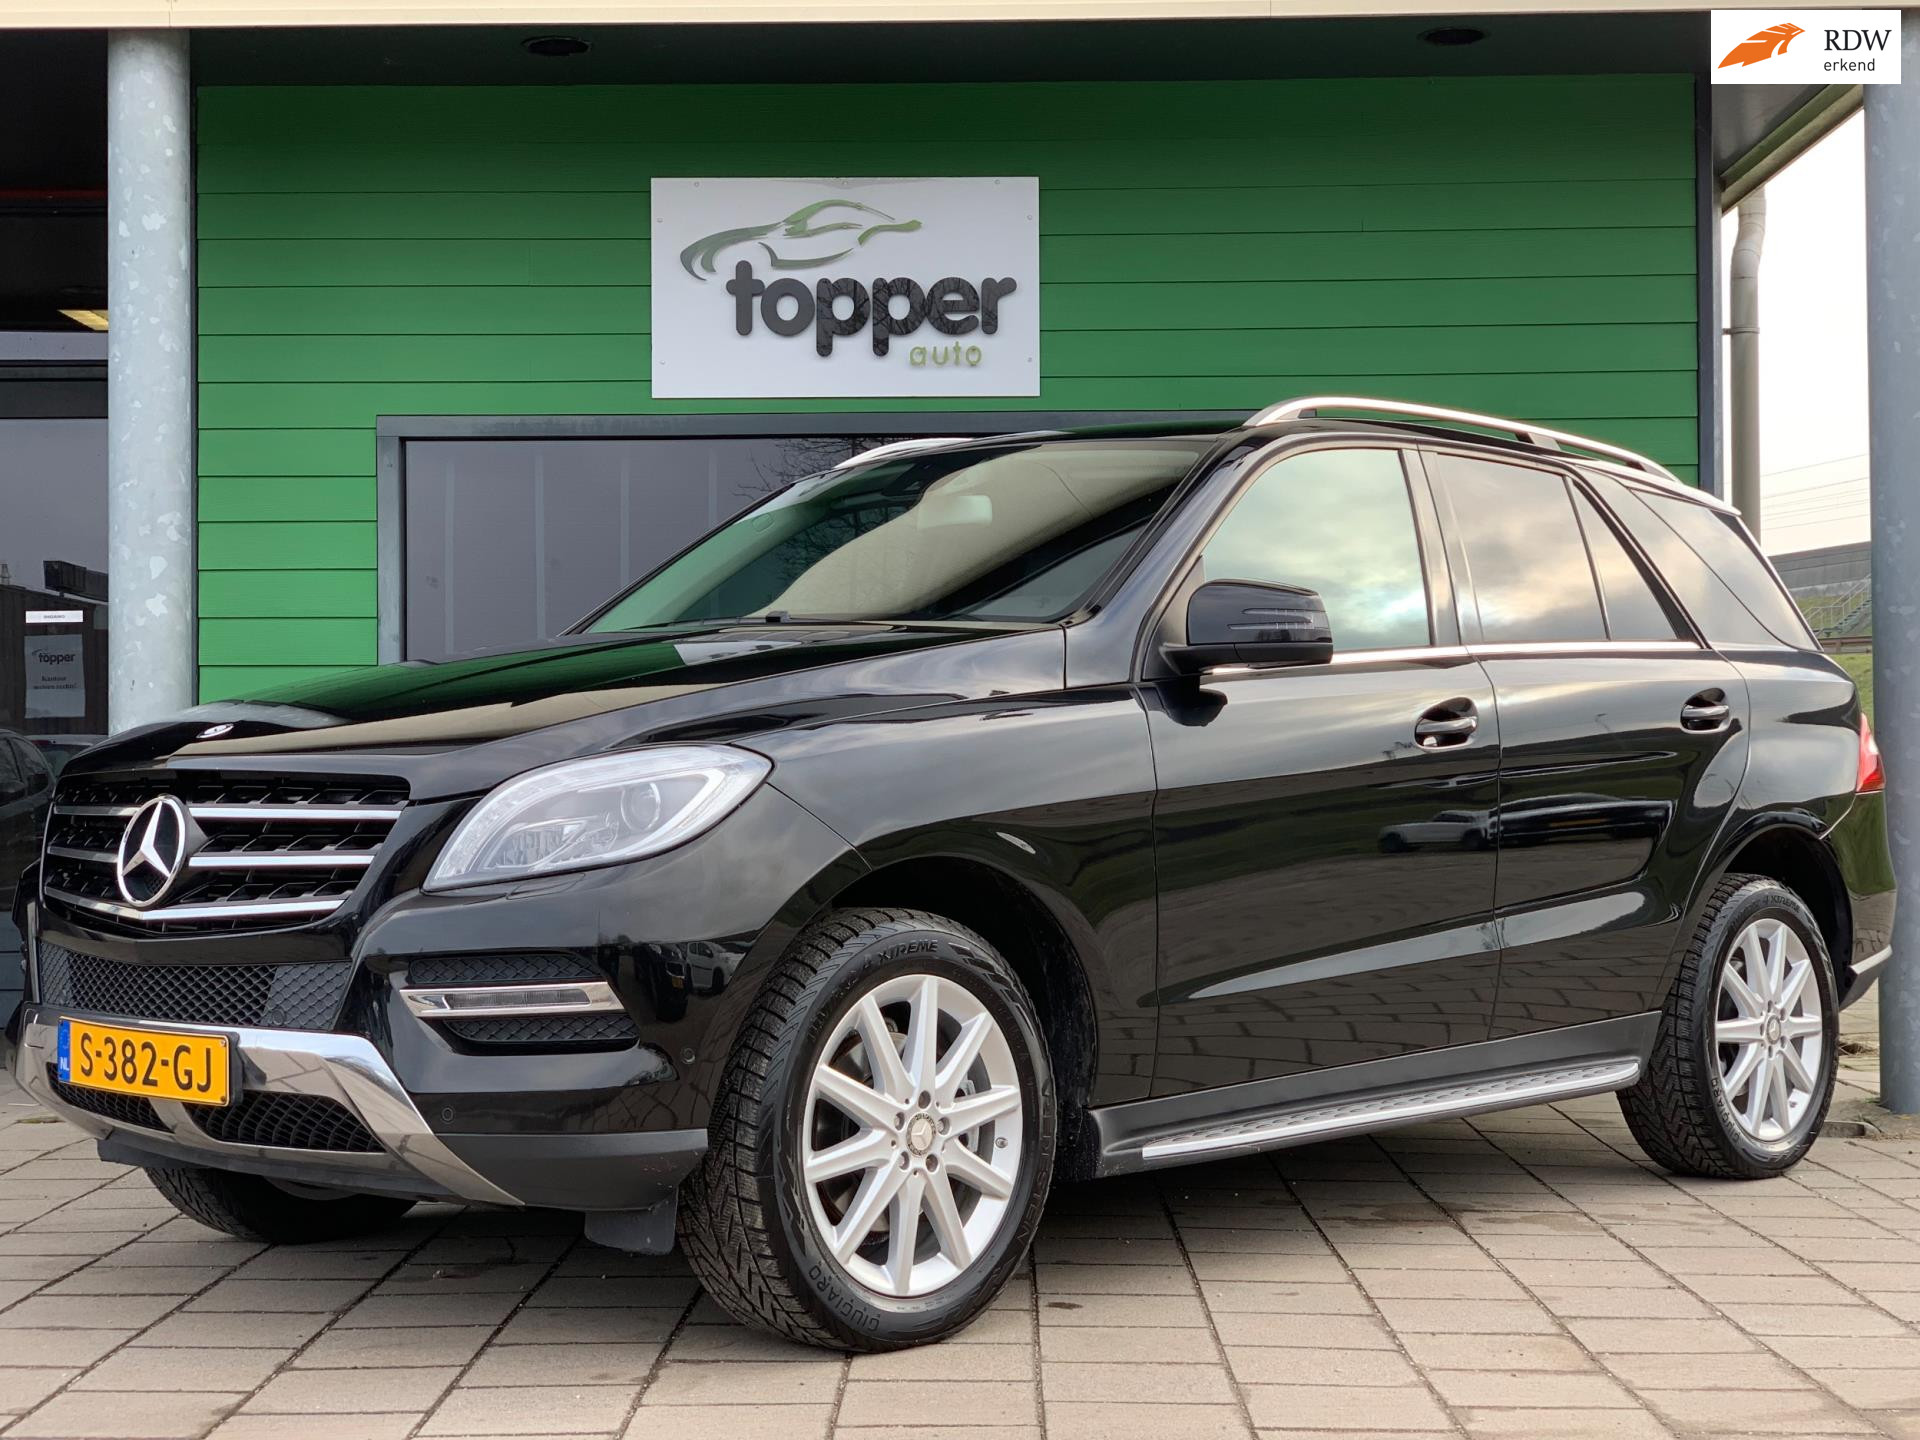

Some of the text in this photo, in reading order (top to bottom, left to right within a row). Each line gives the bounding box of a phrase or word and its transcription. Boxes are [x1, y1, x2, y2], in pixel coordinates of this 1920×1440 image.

[726, 260, 1017, 357] topper
[909, 341, 982, 366] auto
[38, 652, 76, 665] topper
[878, 939, 939, 965] XTREME
[59, 1055, 70, 1072] NL
[80, 1032, 212, 1093] S-382-GJ
[808, 1265, 881, 1332] GIUGIARO
